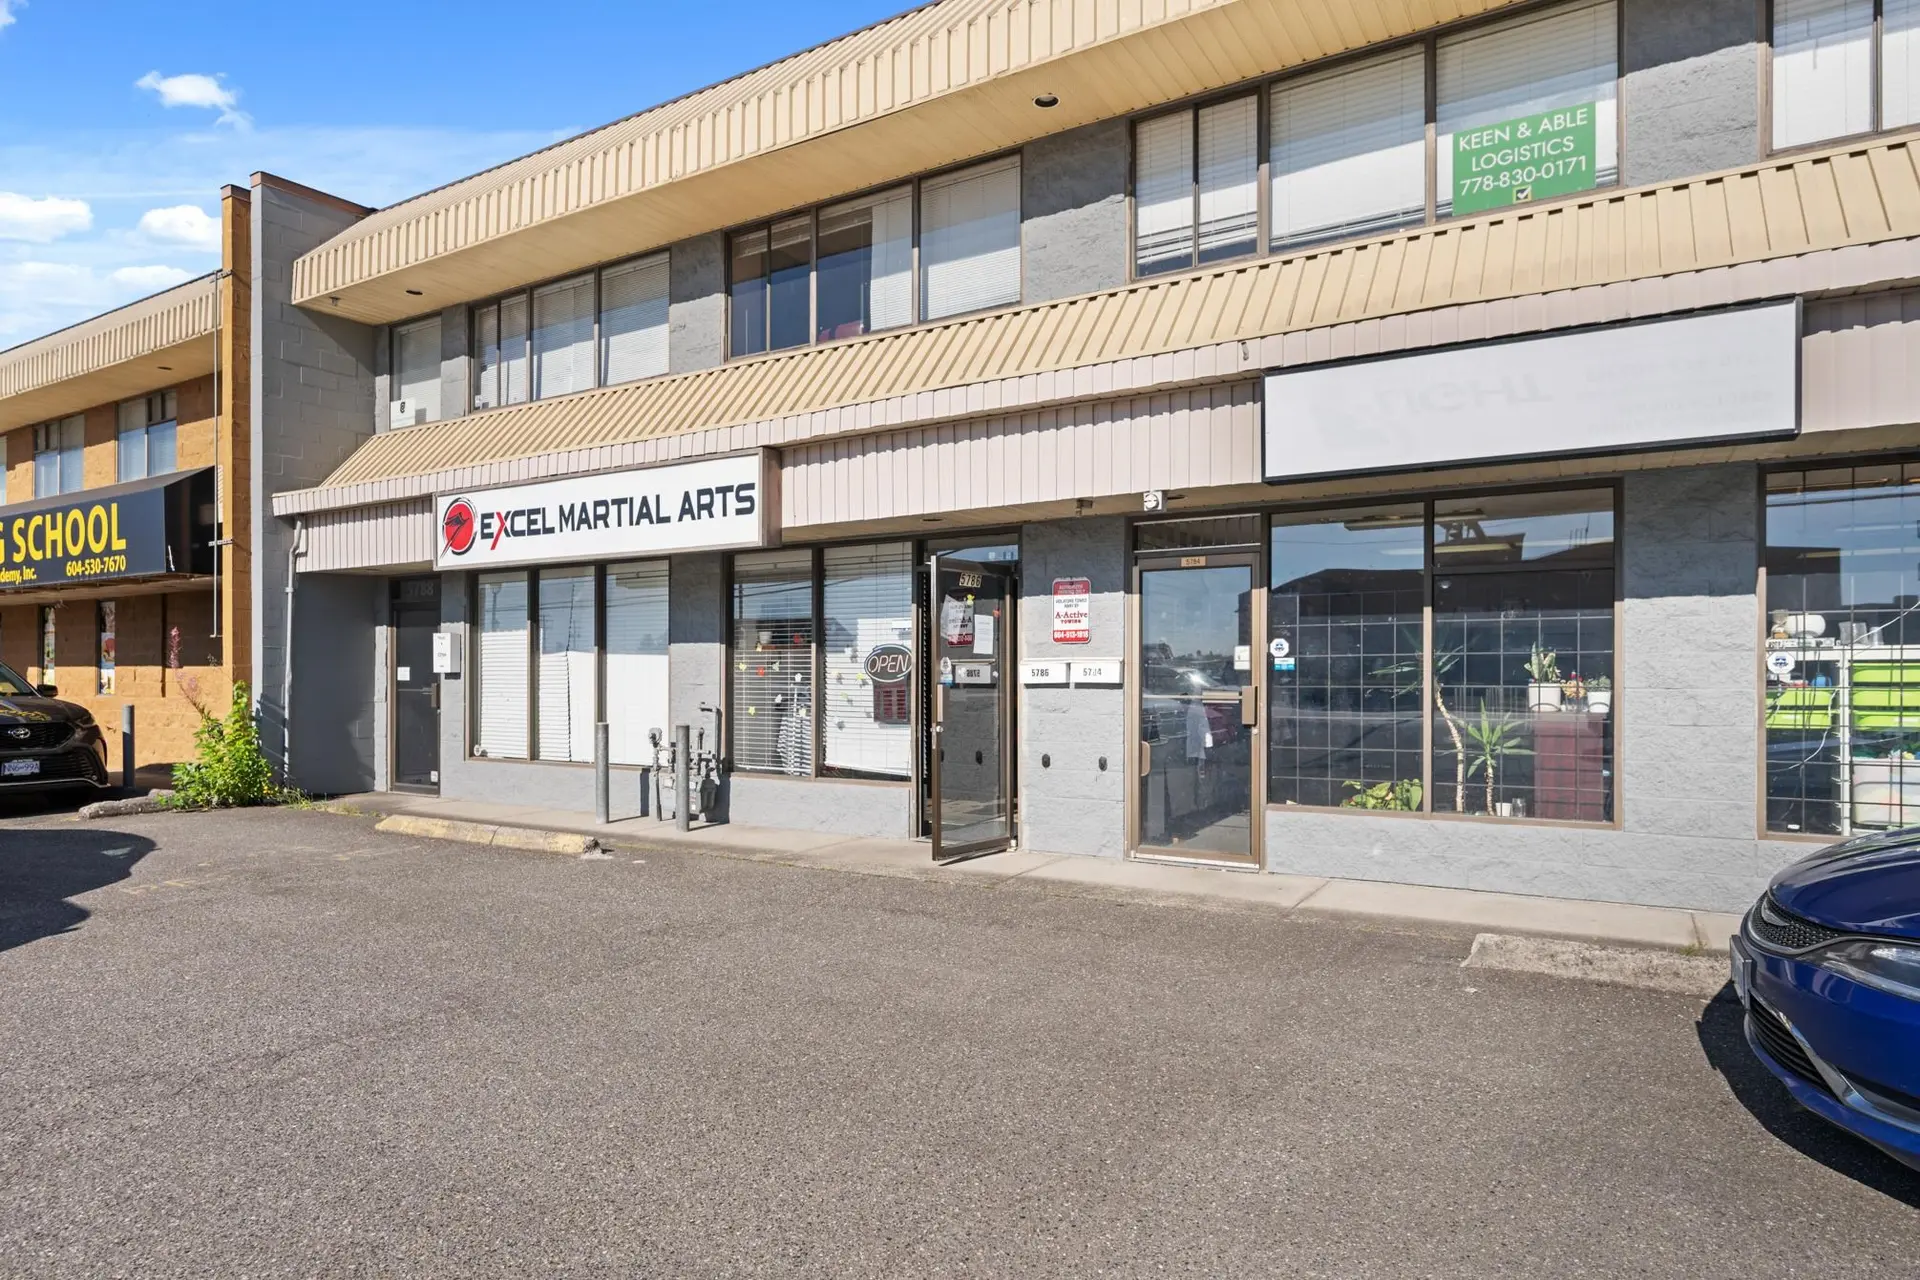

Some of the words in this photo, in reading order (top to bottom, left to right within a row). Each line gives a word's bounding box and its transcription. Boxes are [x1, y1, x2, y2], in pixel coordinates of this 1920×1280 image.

[1459, 126, 1510, 152] KEEN
[1517, 122, 1532, 138] &
[1538, 108, 1588, 134] ABLE
[1472, 136, 1574, 172] LOGISTICS
[1460, 155, 1586, 196] 778-830-0171
[480, 506, 555, 551] EXCEL
[559, 494, 671, 533] MARTIAL
[678, 482, 756, 523] ARTS
[12, 502, 127, 563] SCHOOL
[23, 565, 37, 580] Inc.
[66, 554, 126, 577] 604-530-7670
[960, 573, 981, 587] 5786
[1055, 611, 1088, 619] A-Active
[868, 654, 909, 673] OPEN
[1031, 668, 1050, 677] 5786
